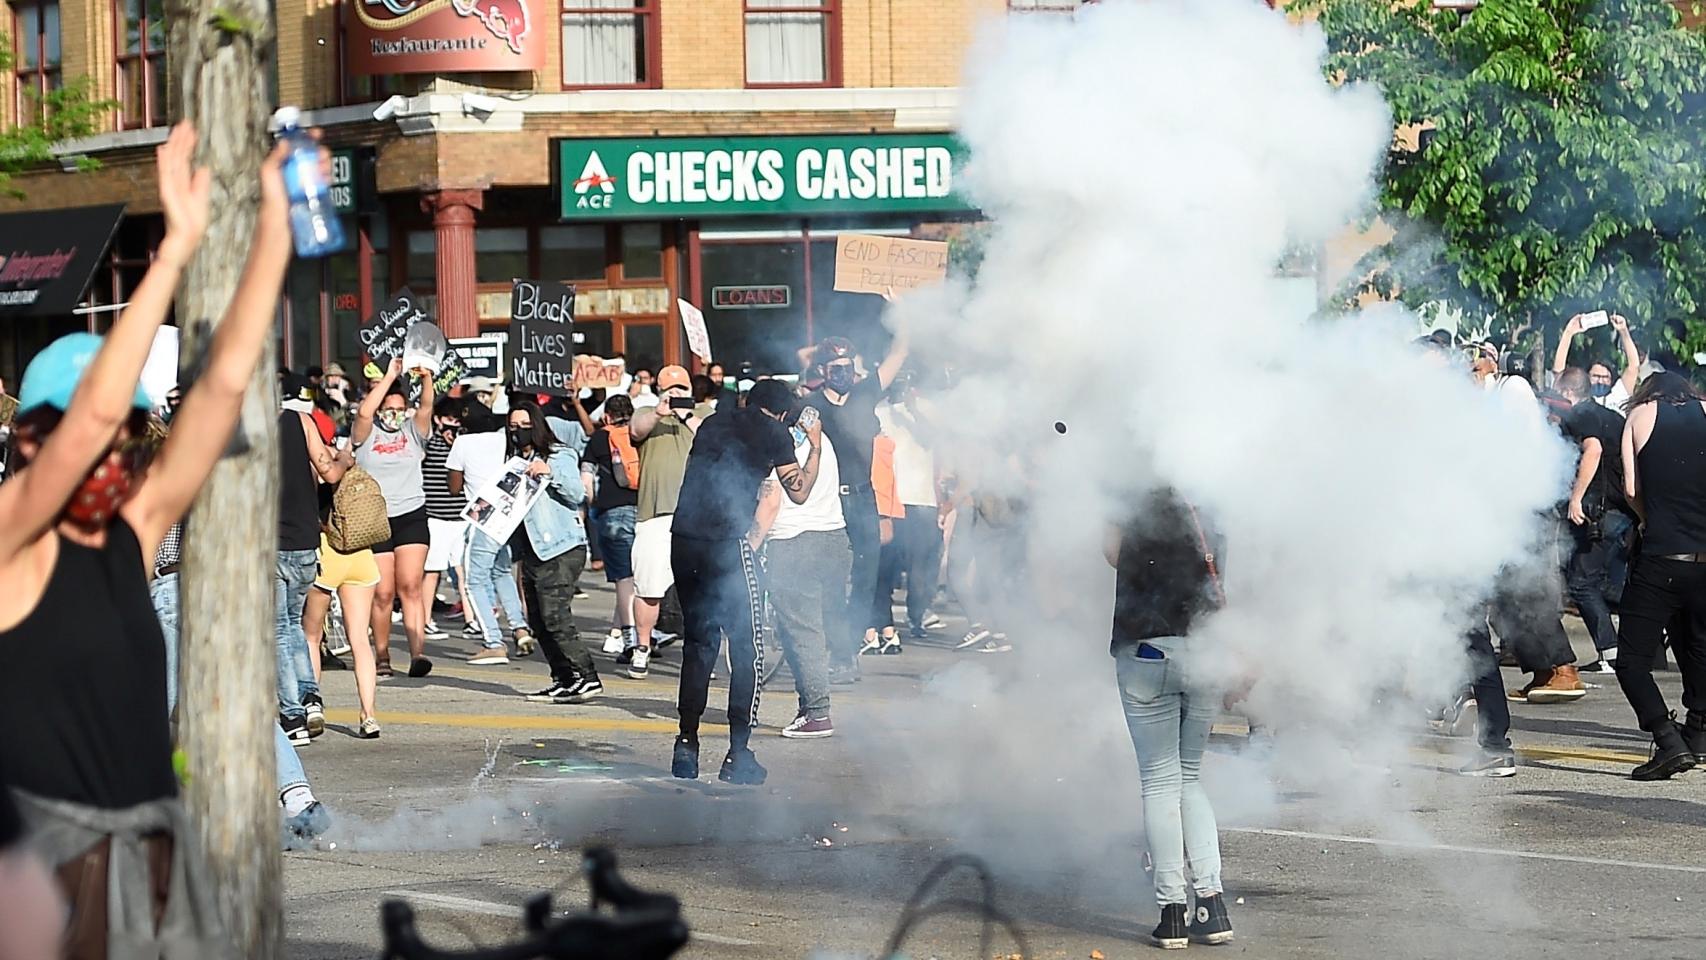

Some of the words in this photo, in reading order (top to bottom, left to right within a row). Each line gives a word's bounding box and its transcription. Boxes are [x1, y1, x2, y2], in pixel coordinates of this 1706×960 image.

[371, 37, 488, 56] Restaurante
[331, 155, 350, 183] ED
[627, 149, 784, 203] CHECKS
[796, 147, 952, 200] CASHED
[576, 194, 612, 209] ACE
[844, 239, 880, 261] END
[513, 282, 574, 323] Black
[718, 288, 785, 305] LOANS
[521, 324, 566, 358] Lives
[513, 356, 573, 389] Matter
